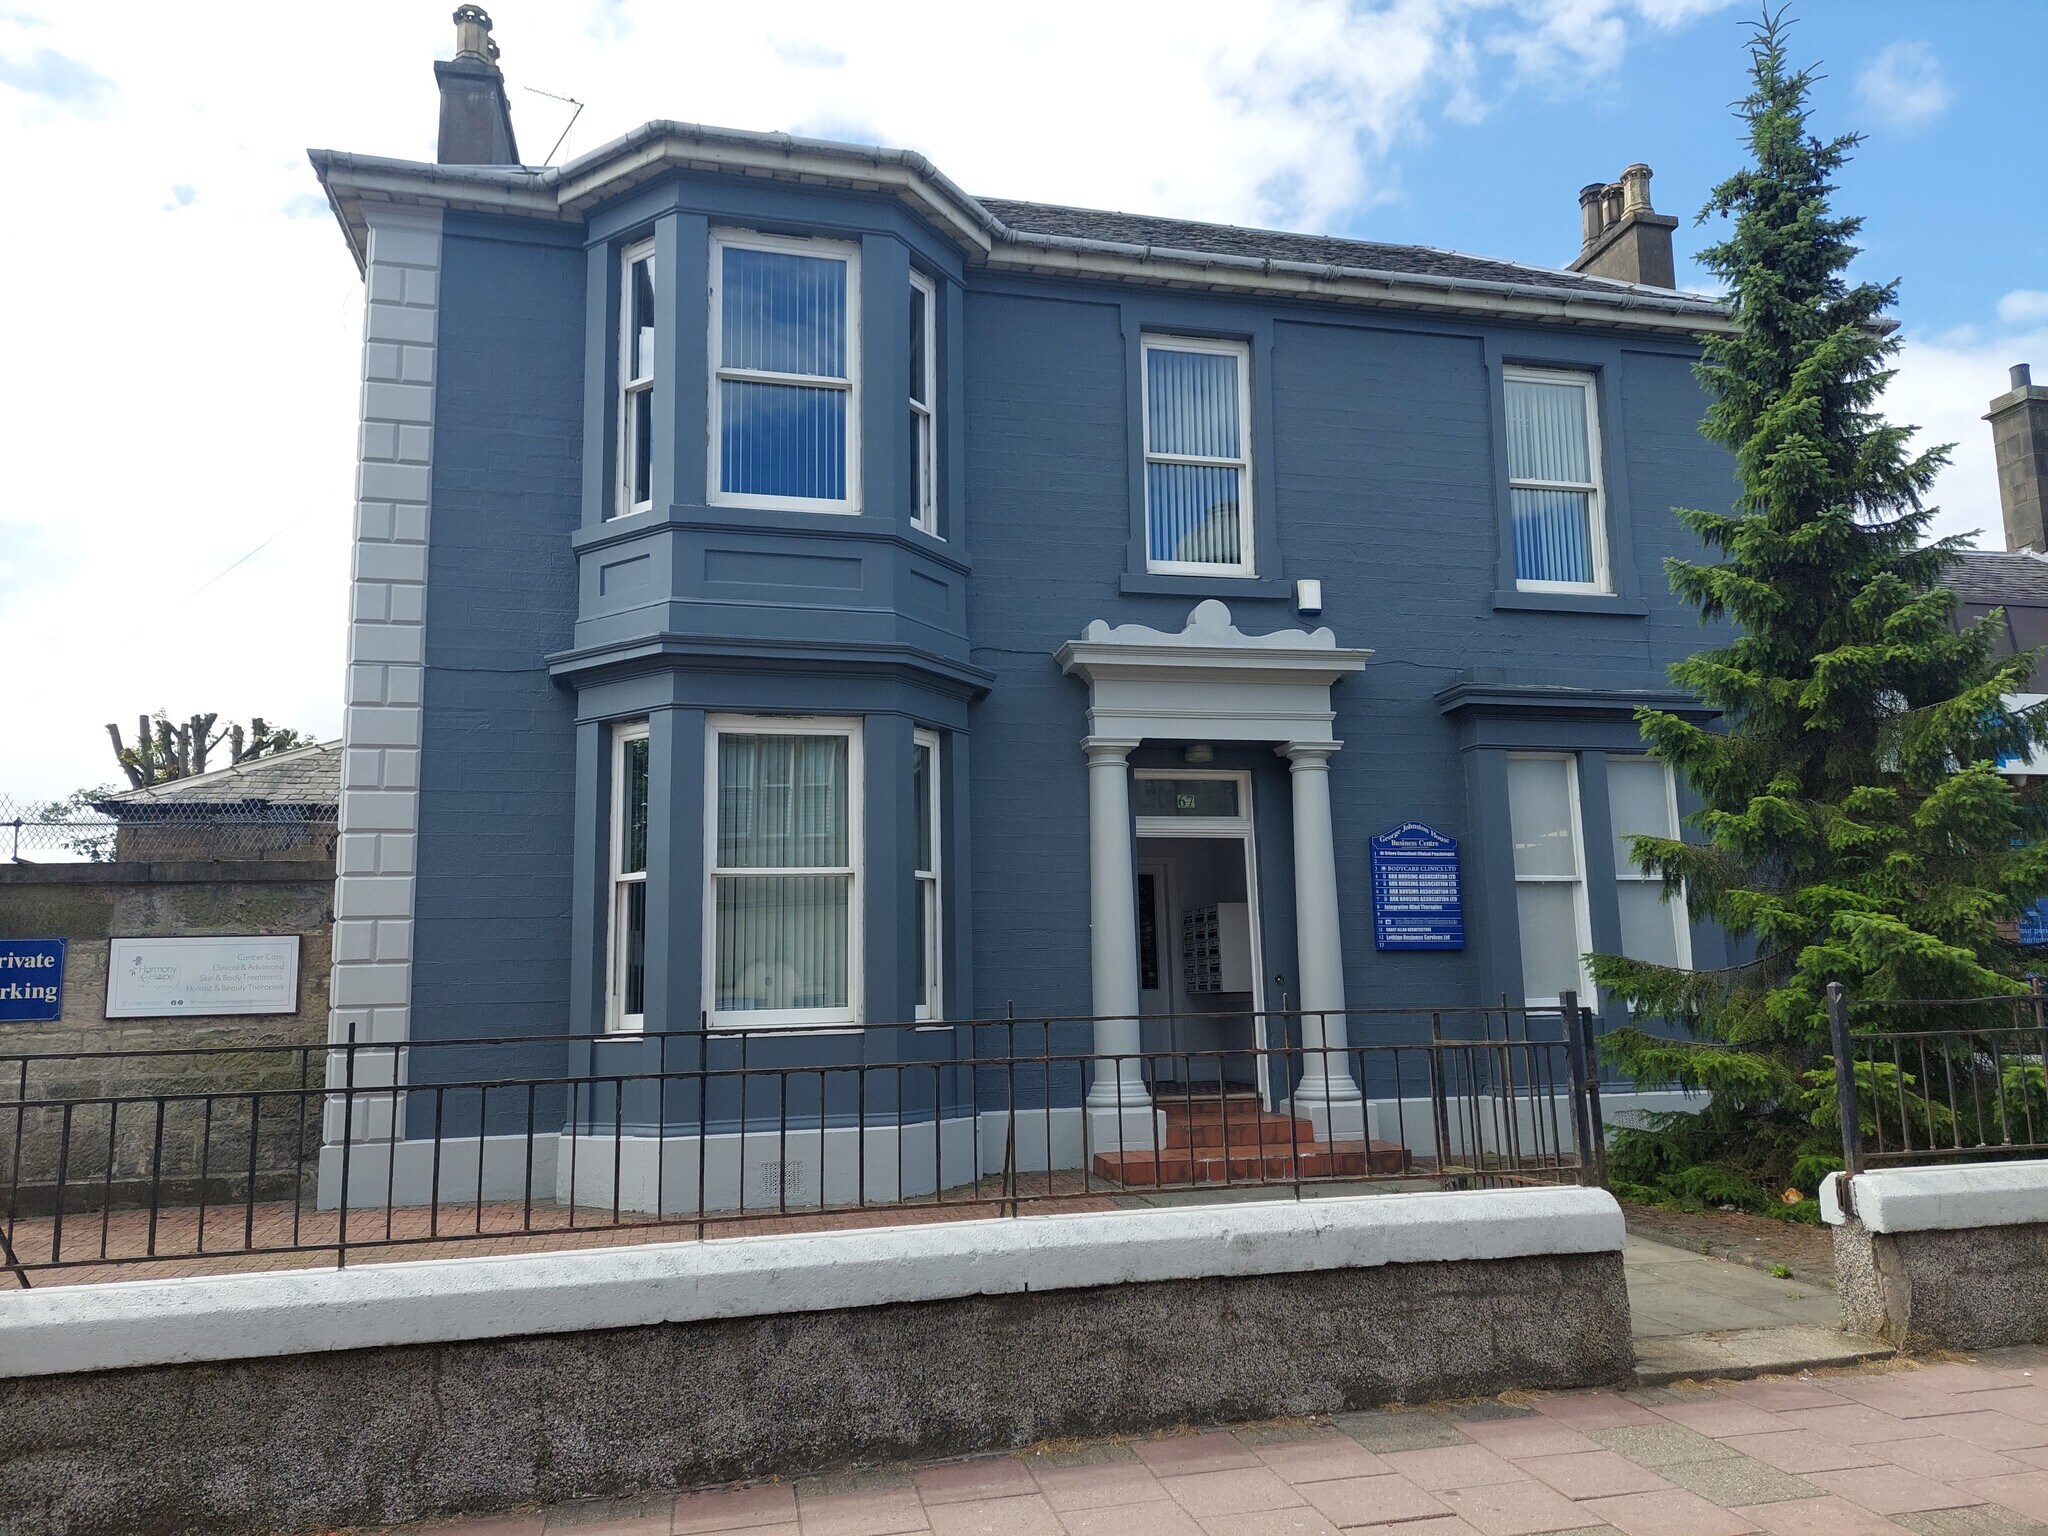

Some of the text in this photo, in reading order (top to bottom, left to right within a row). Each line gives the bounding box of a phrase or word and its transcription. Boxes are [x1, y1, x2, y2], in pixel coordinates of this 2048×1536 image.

[1179, 795, 1194, 808] 67
[1379, 823, 1450, 843] George Johnston House
[1391, 839, 1418, 847] Business
[1423, 934, 1444, 942] Services
[0, 951, 55, 969] rivate
[236, 953, 265, 961] Cancer
[138, 964, 178, 975] Harmony
[212, 963, 285, 971] Clinical & Advanced
[199, 974, 214, 982] Skin
[214, 974, 222, 982] &
[222, 973, 241, 982] Body
[0, 982, 58, 1003] rking
[186, 982, 285, 993] Holistic & Beauty Therapies
